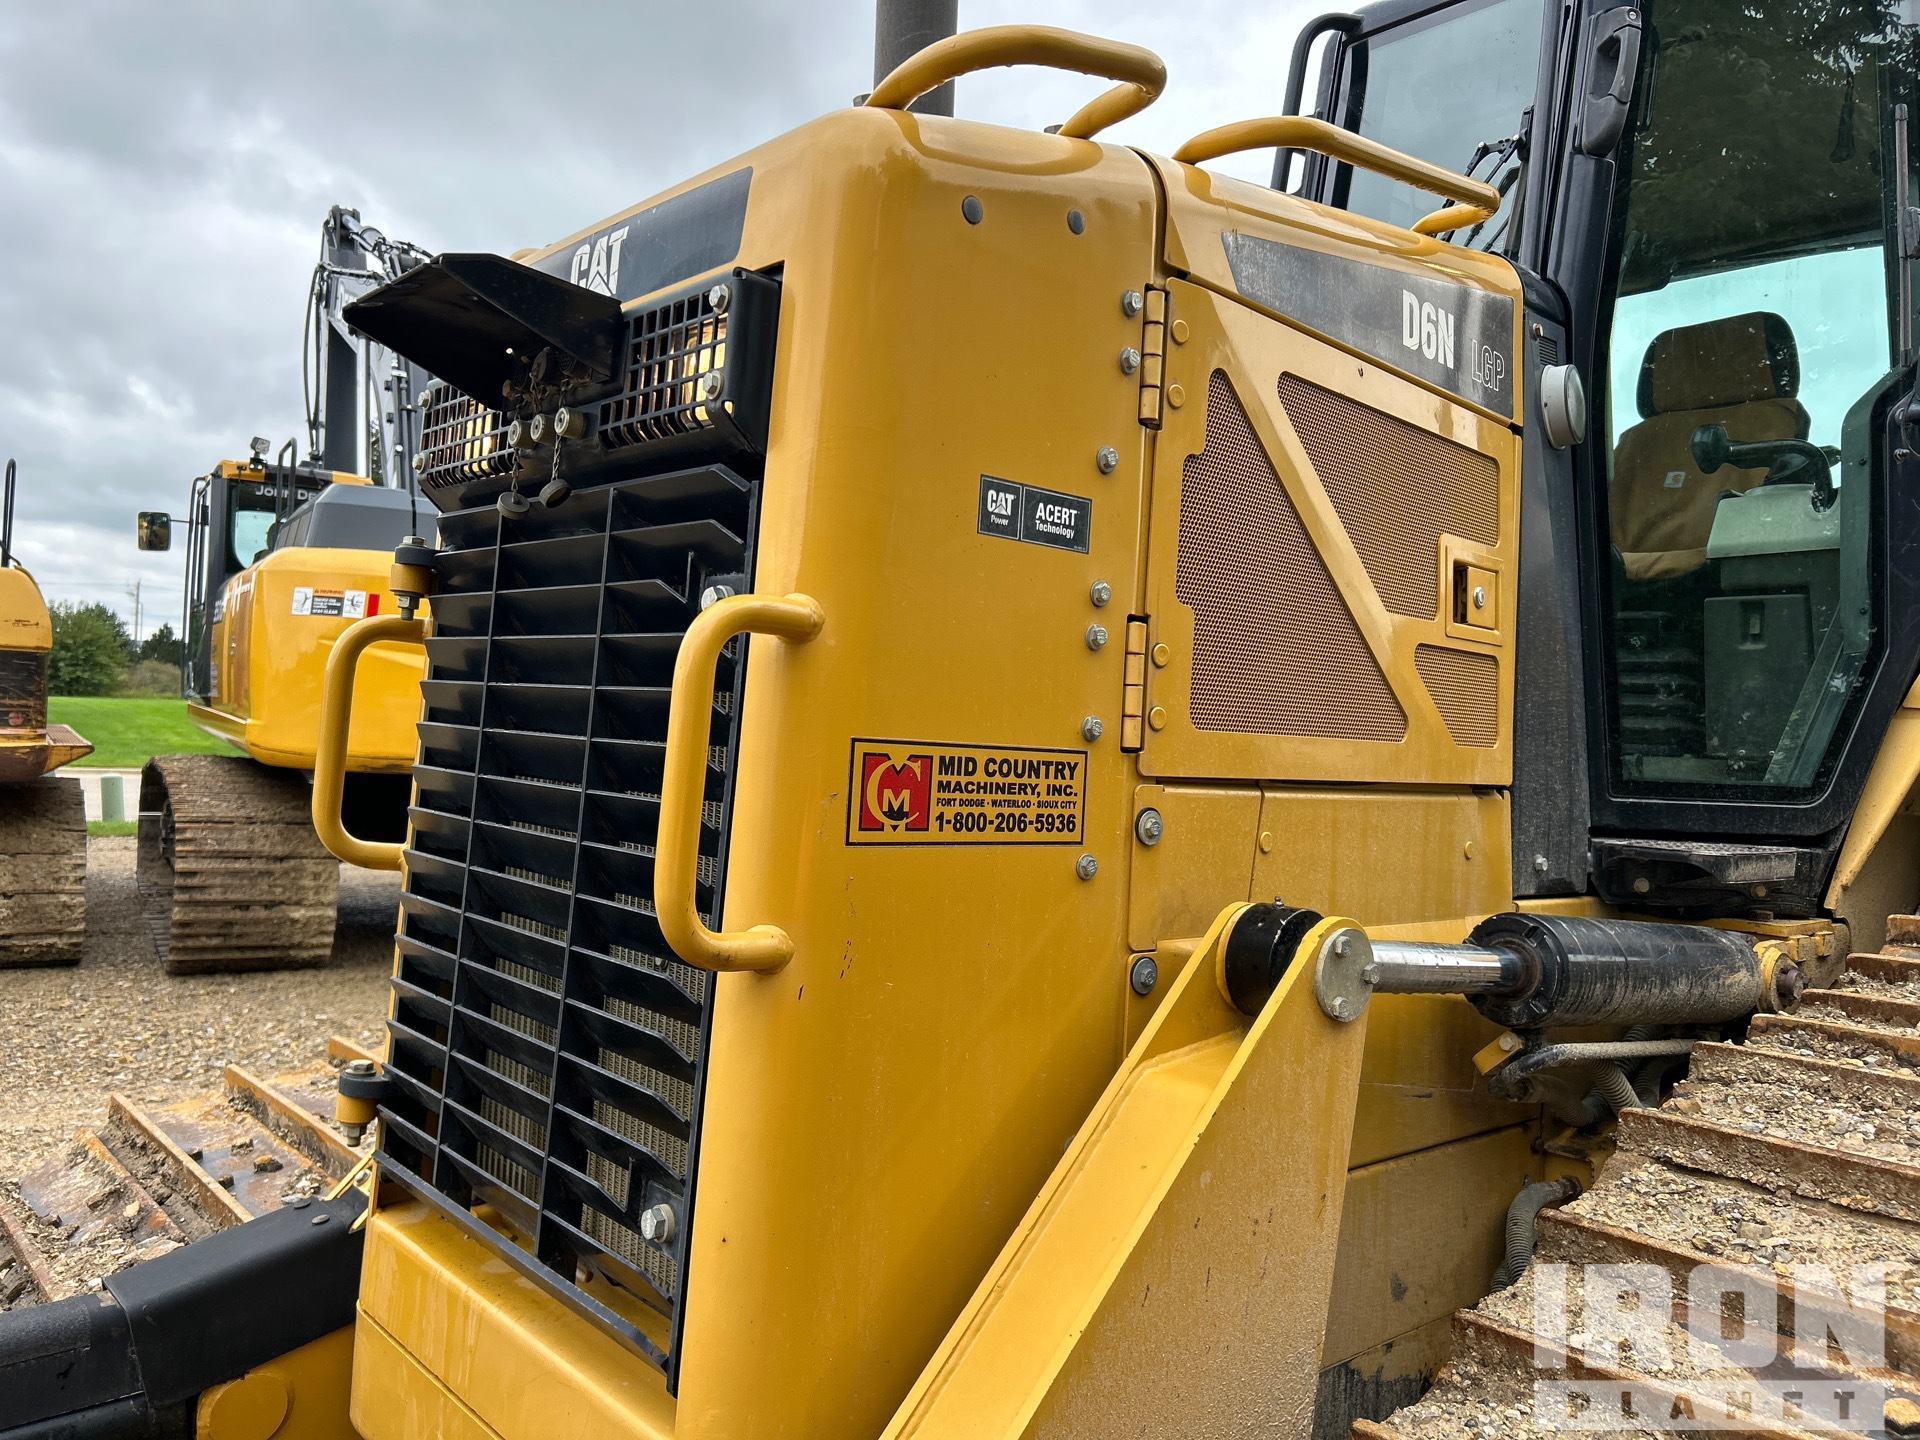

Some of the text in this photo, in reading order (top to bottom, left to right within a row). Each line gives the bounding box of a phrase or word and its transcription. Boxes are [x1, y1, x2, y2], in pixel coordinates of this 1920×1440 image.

[570, 226, 629, 296] CAT
[1402, 289, 1505, 392] D6N LGP
[987, 490, 1014, 516] CAT
[1035, 502, 1078, 527] ACERT
[990, 515, 1009, 526] Power
[1035, 520, 1075, 539] Technology
[938, 755, 1079, 781] MID COUNTRY
[937, 780, 1078, 798] MACHINERY, INC.
[936, 798, 1078, 810] FORT DODGE WATERLOO SIOUX CITY
[935, 811, 1076, 833] 1-800-206-5936
